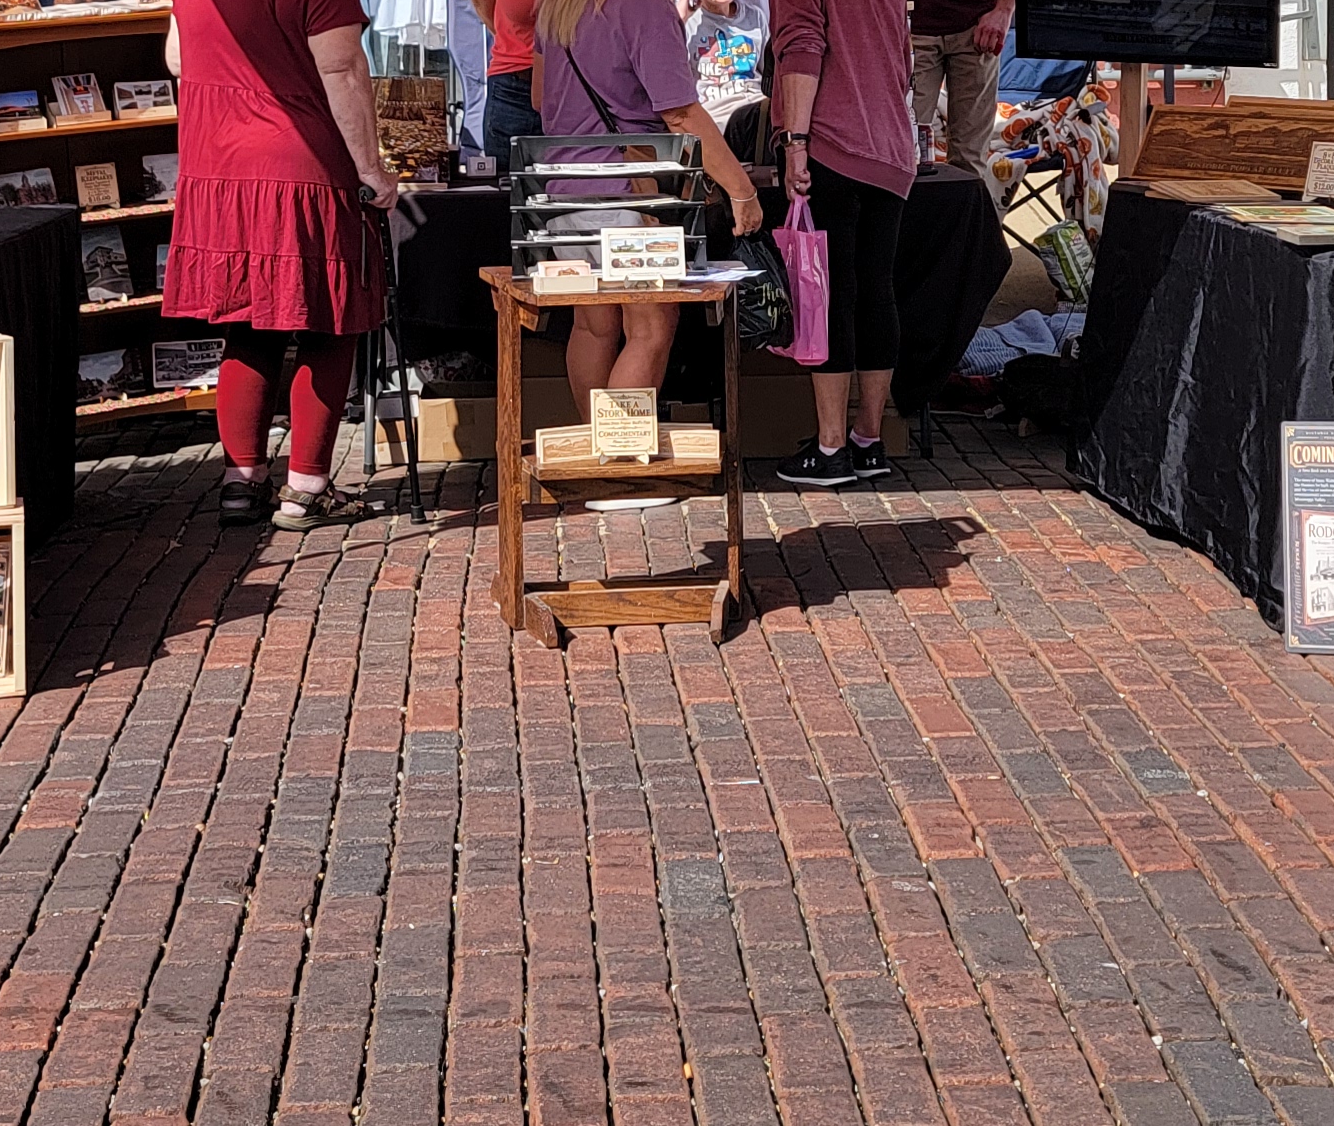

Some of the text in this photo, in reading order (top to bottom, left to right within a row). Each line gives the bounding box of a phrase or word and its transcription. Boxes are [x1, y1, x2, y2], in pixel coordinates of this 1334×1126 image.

[609, 400, 640, 409] TAKE A
[597, 408, 652, 418] STORY HOME
[598, 430, 652, 438] COMPLIMENTARY
